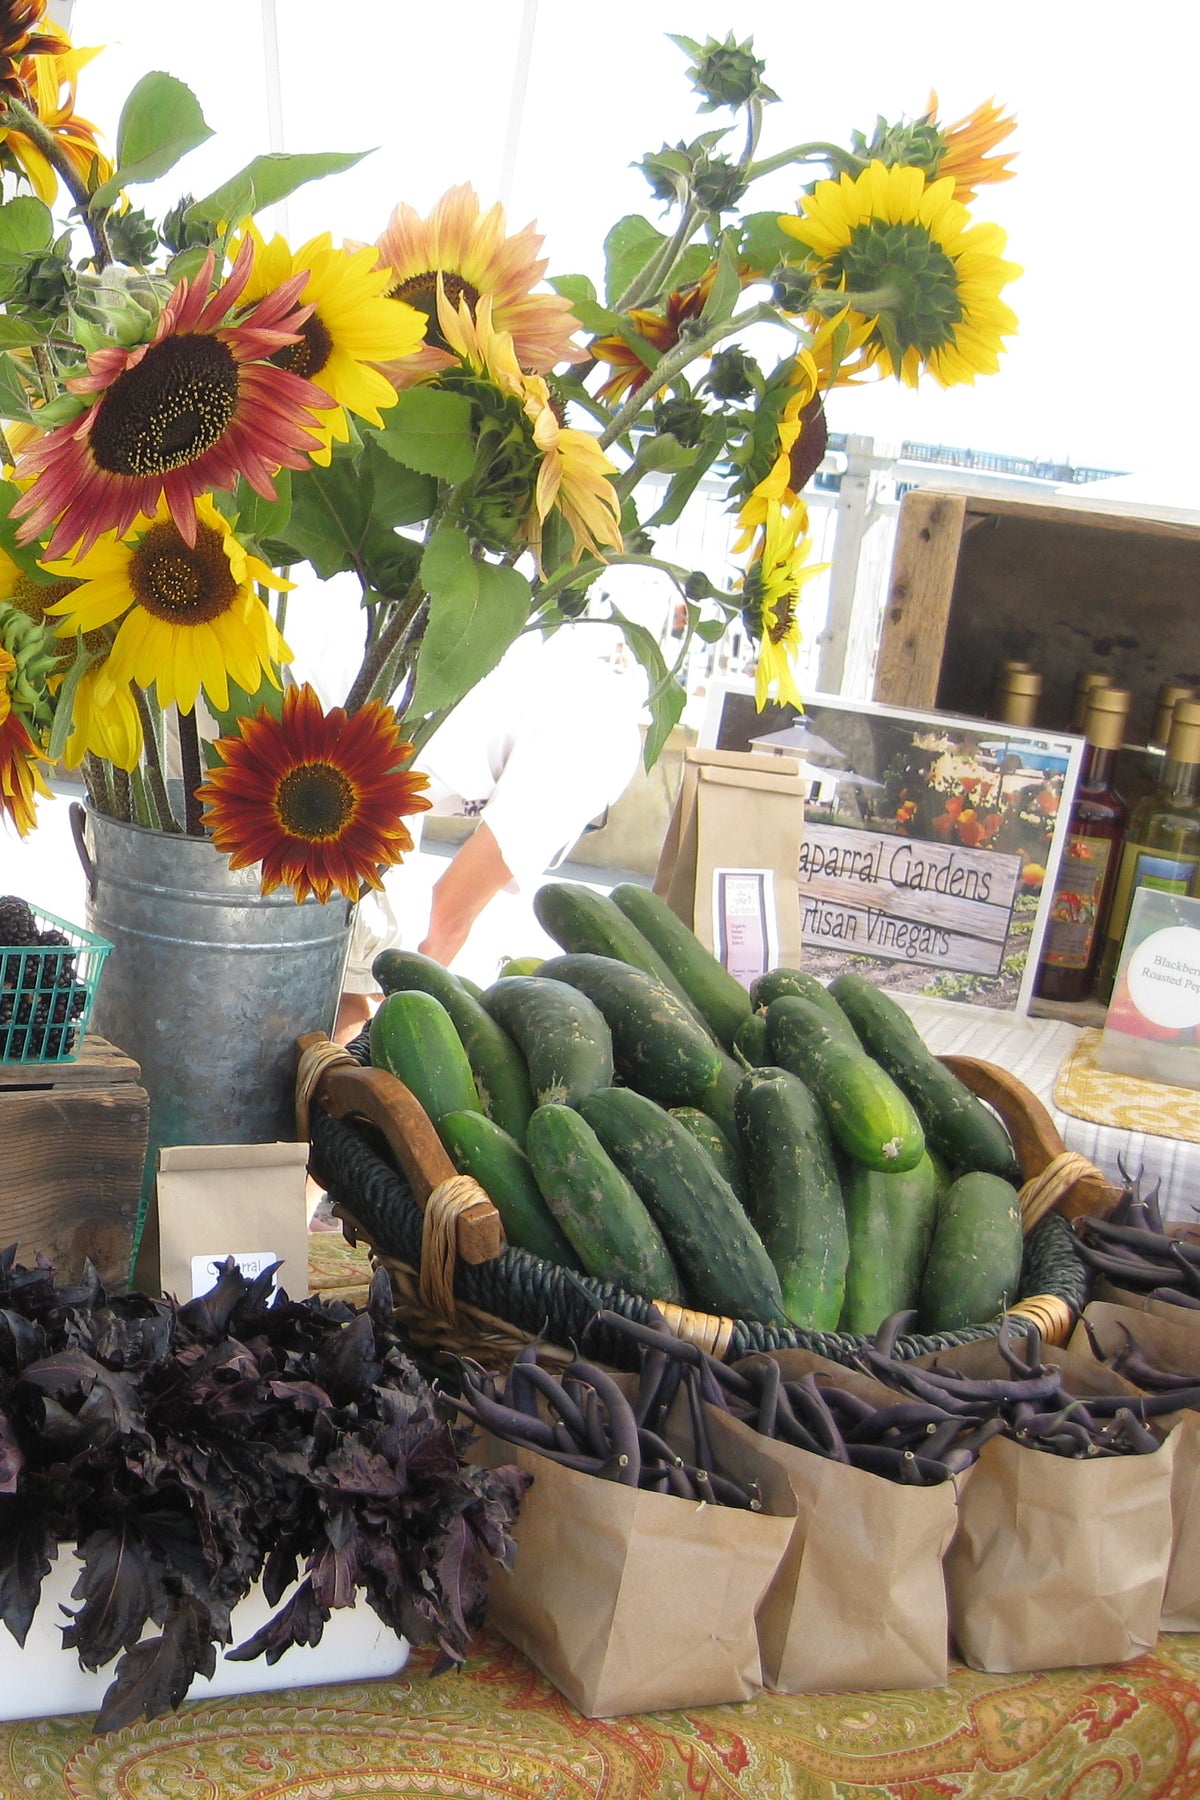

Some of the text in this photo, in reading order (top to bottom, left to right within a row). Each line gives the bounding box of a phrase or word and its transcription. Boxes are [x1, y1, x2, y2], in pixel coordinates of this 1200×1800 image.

[798, 841, 992, 901] aparral Gardens
[801, 899, 951, 958] rtisan Vinegars
[1142, 967, 1183, 987] Roasted
[207, 1260, 260, 1275] Crral
